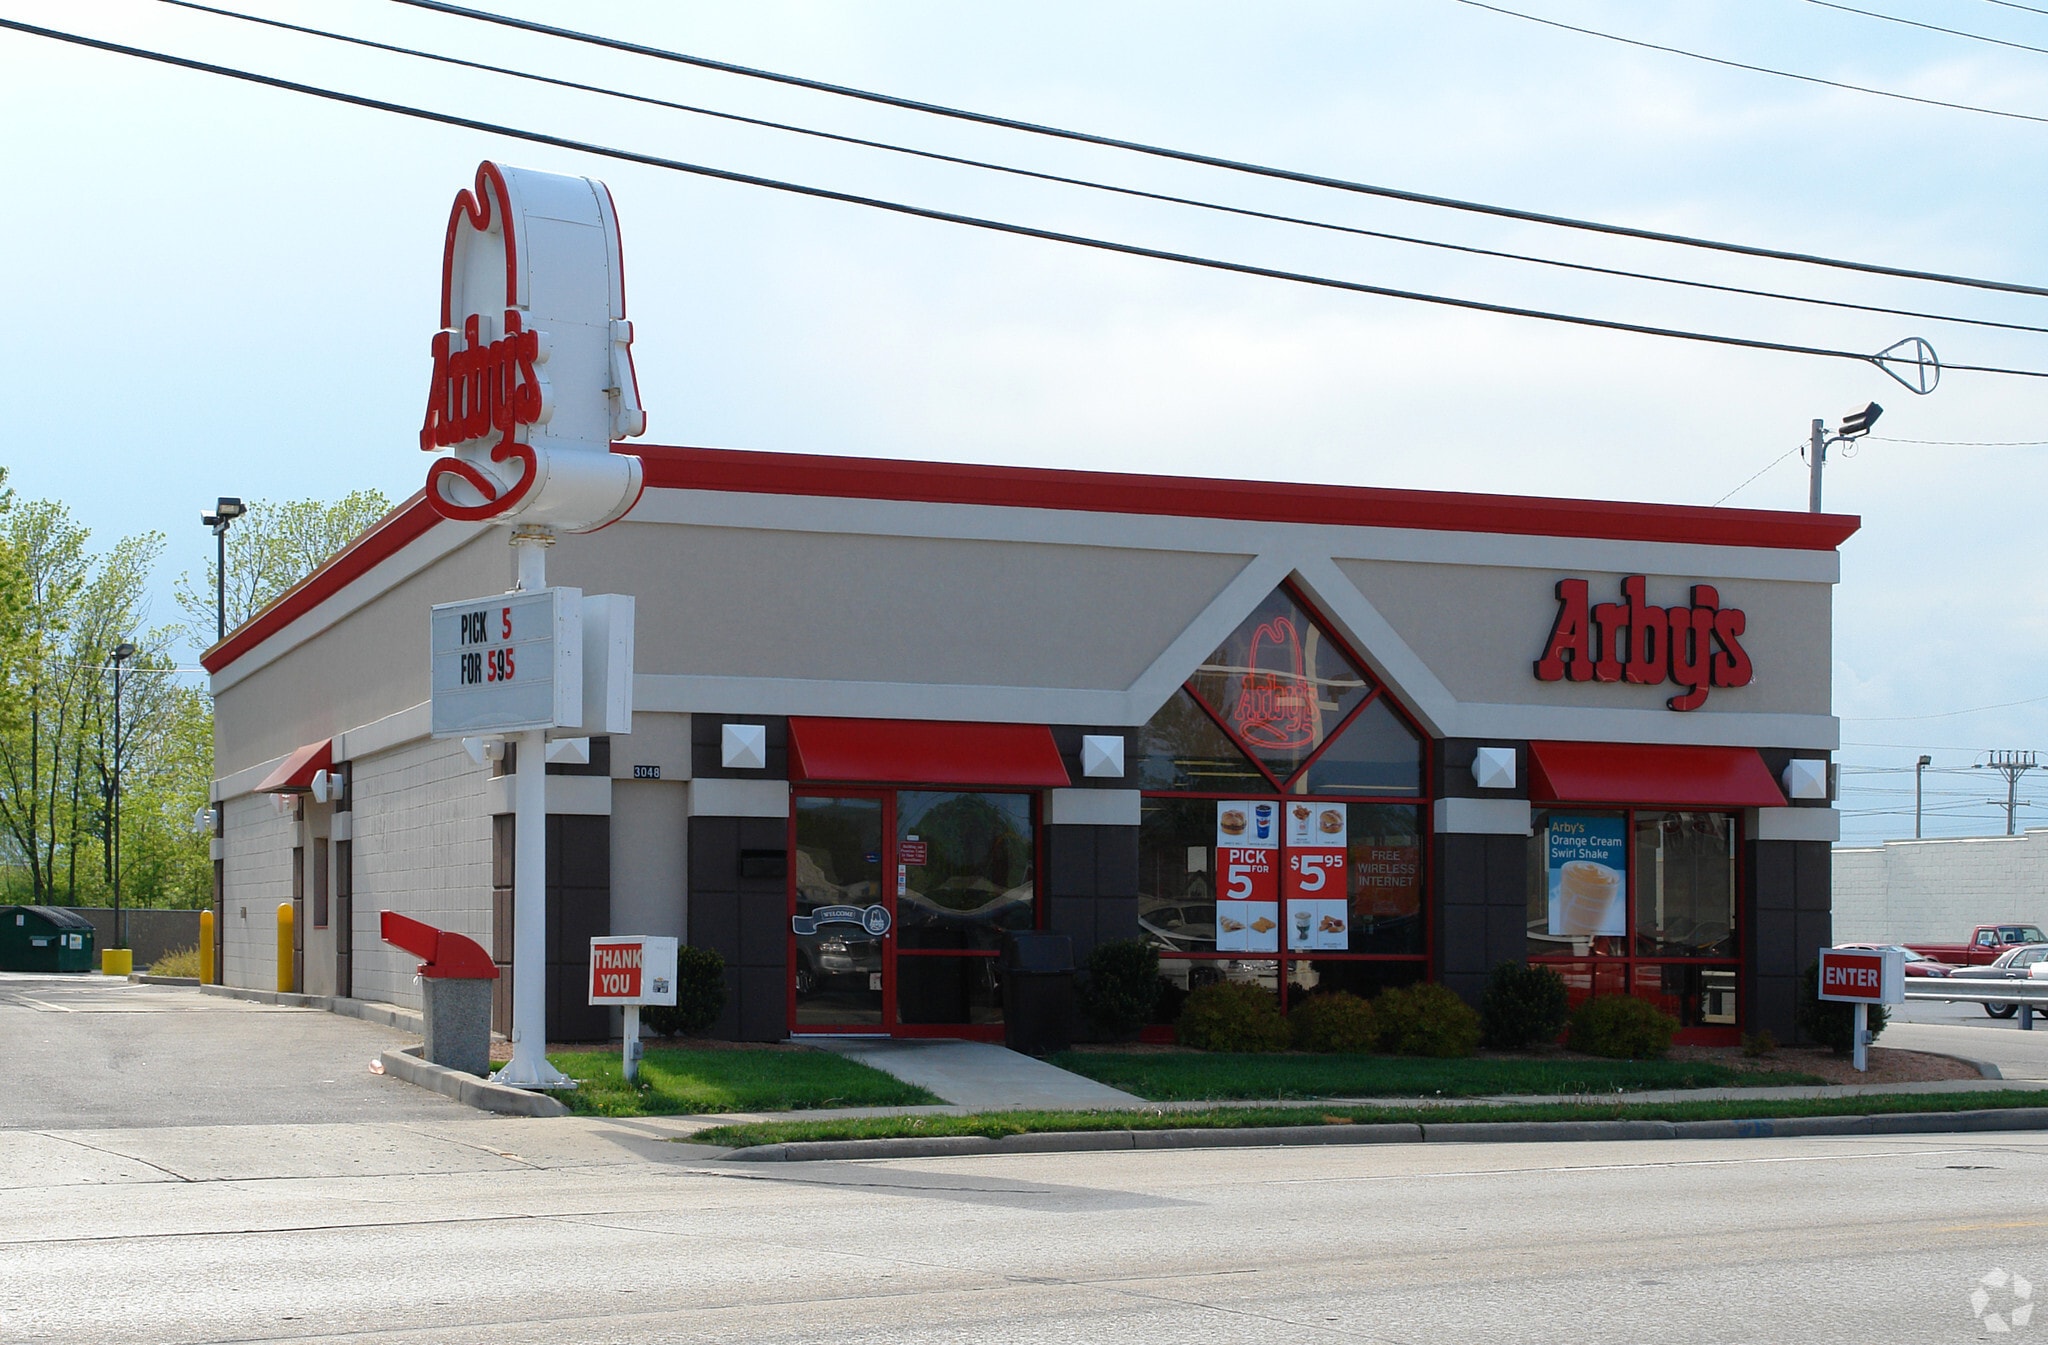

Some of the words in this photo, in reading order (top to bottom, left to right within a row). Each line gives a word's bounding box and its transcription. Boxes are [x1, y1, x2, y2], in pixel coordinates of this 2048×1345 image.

[419, 309, 542, 462] Arby's
[461, 611, 487, 646] PICK
[502, 607, 512, 640] 5
[1532, 575, 1753, 712] Arby's
[461, 652, 482, 685] FOR
[487, 648, 515, 682] 595
[1234, 673, 1320, 732] Arby's
[634, 766, 660, 778] 3048
[1552, 822, 1585, 835] Arby's
[1551, 834, 1588, 848] Orange
[1590, 835, 1622, 847] Cream
[1229, 849, 1267, 864] PICK
[1371, 850, 1400, 860] FREE
[1551, 848, 1576, 858] Swirl
[1579, 848, 1609, 859] Shake
[1358, 863, 1415, 874] WIRELESS
[1226, 864, 1253, 899] 5
[1252, 865, 1269, 873] FOR
[1359, 876, 1413, 887] INTERNET
[593, 949, 642, 969] THANK
[601, 974, 630, 993] YOU
[1825, 966, 1878, 987] ENTER
